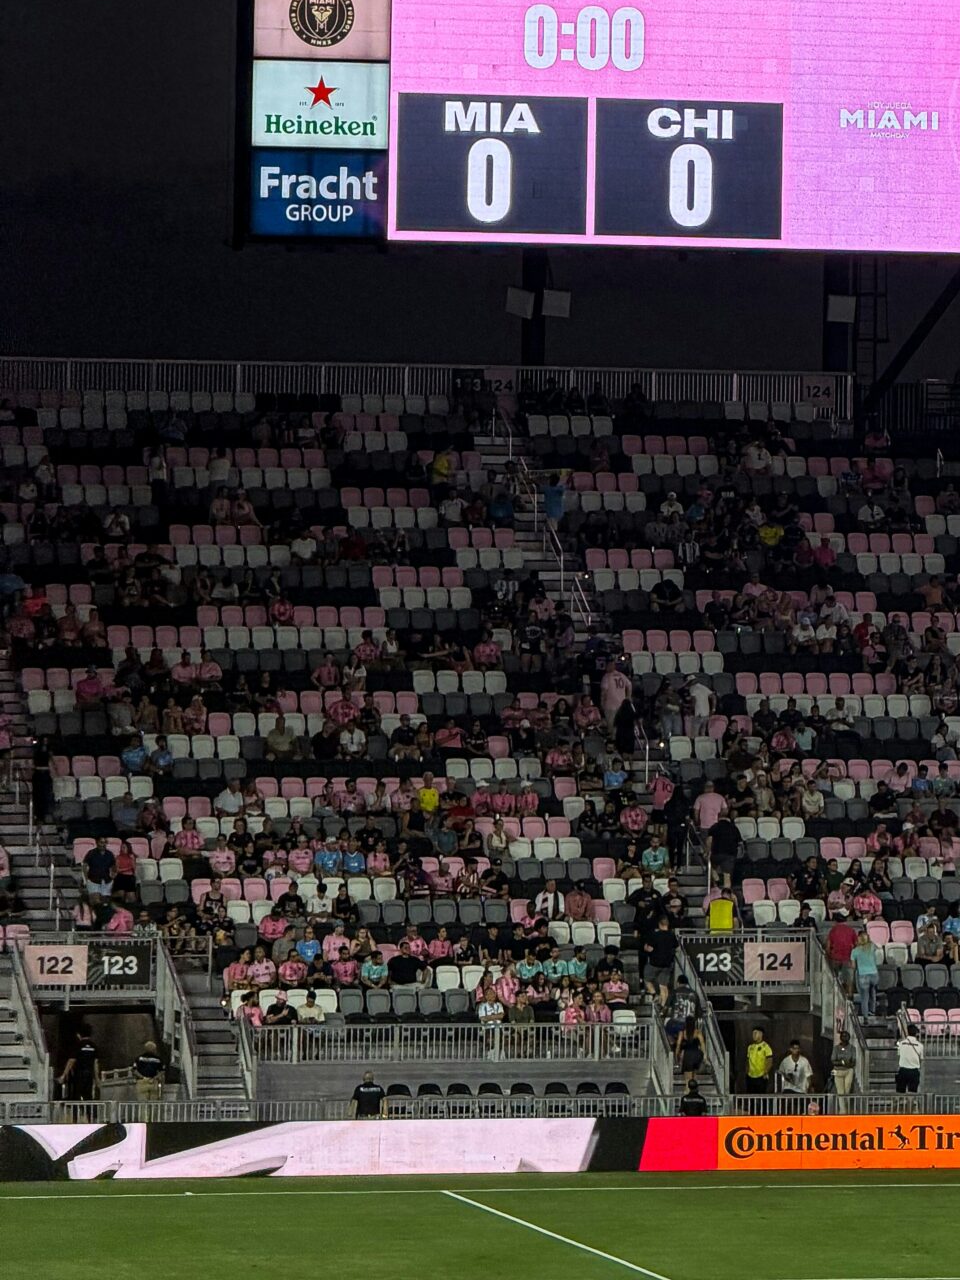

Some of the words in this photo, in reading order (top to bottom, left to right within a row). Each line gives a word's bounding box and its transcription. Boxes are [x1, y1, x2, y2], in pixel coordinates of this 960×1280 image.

[524, 3, 645, 72] 0:00
[264, 114, 376, 136] Heineken
[444, 100, 540, 133] MIA
[647, 107, 734, 140] CHI
[840, 108, 939, 130] MIAMI
[260, 166, 378, 200] Fracht
[467, 138, 512, 223] 0
[669, 143, 713, 227] 0
[286, 204, 354, 222] GROUP
[488, 380, 512, 391] 124
[807, 385, 831, 397] 124
[37, 956, 73, 974] 122
[101, 956, 138, 975] 123
[696, 953, 732, 971] 123
[757, 953, 793, 970] 124
[725, 1126, 885, 1158] Continental
